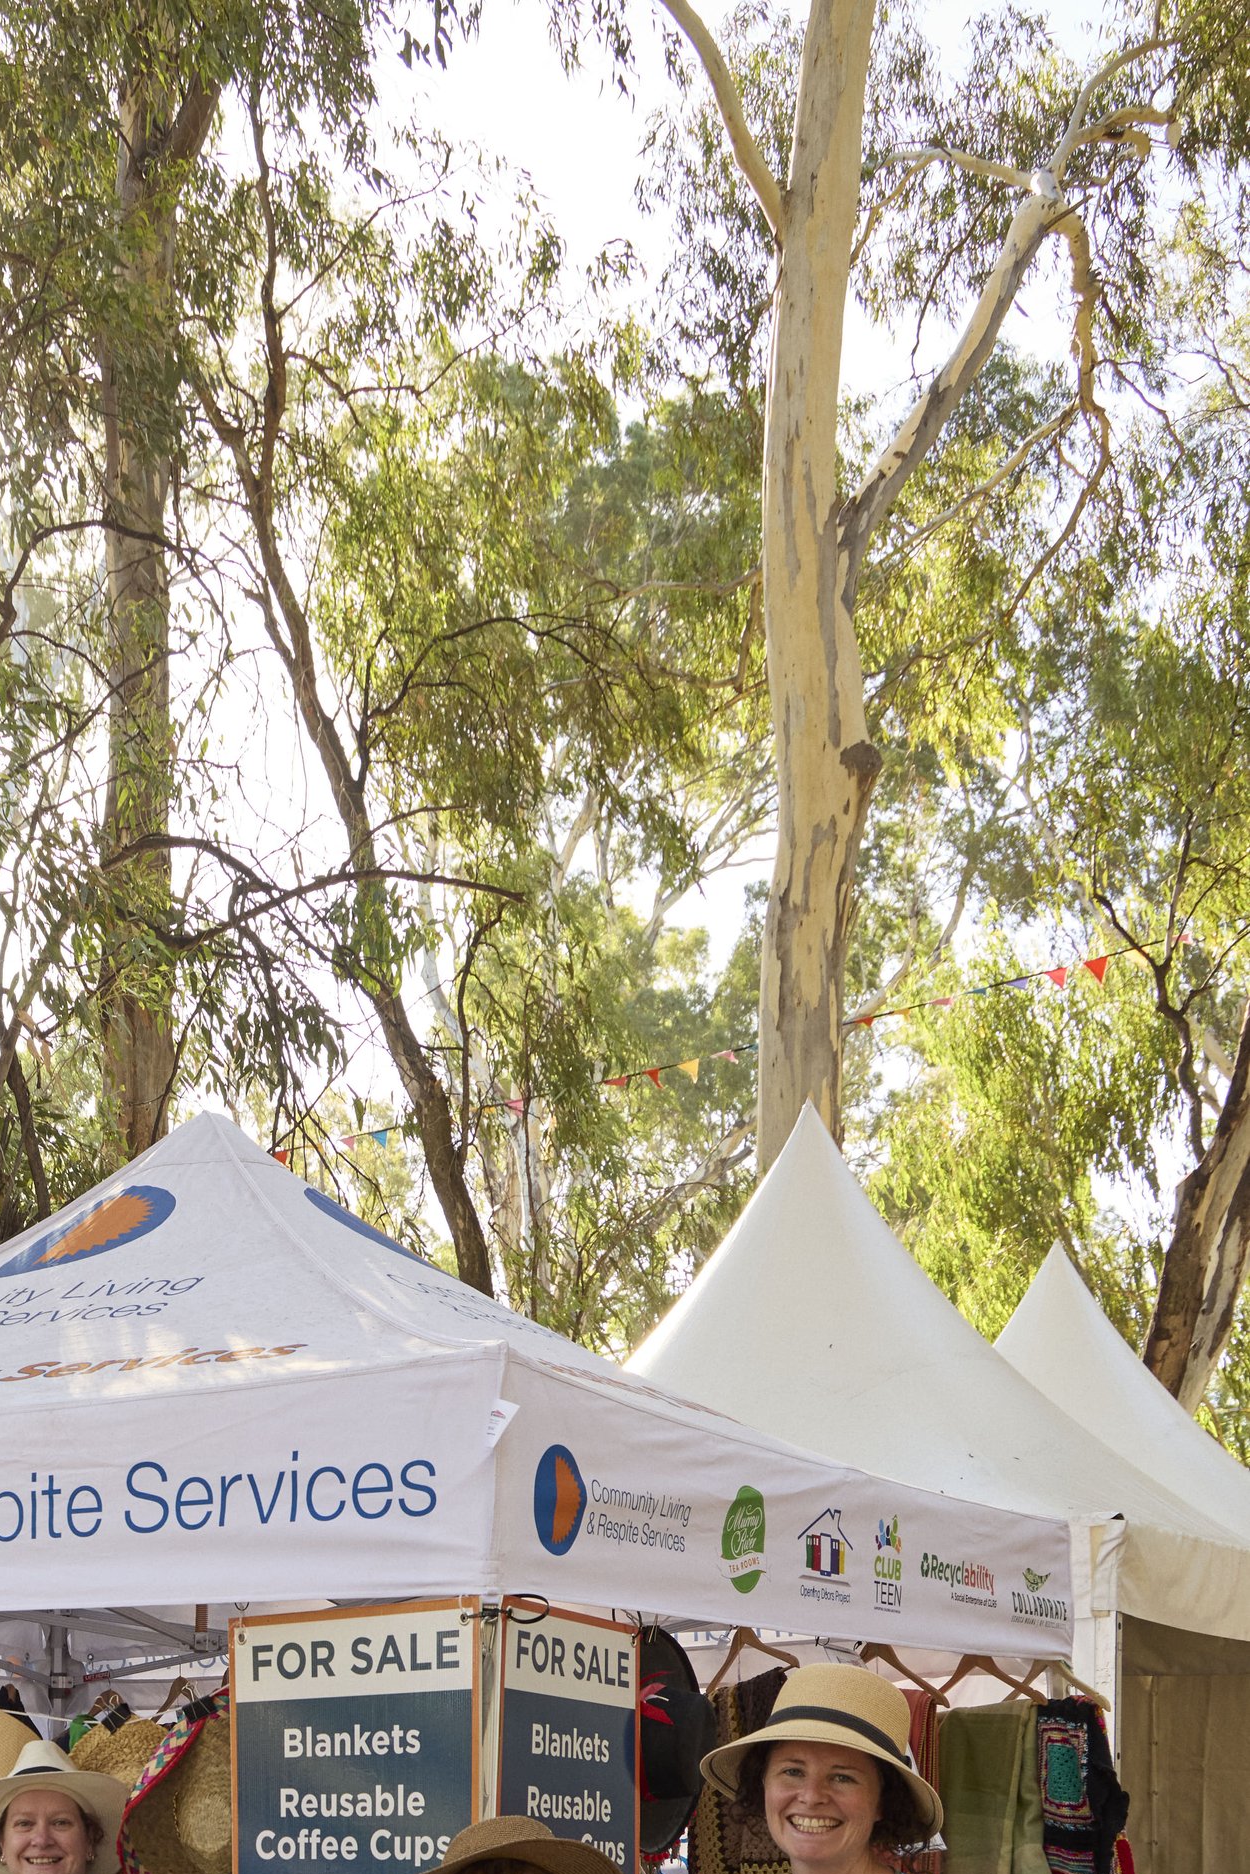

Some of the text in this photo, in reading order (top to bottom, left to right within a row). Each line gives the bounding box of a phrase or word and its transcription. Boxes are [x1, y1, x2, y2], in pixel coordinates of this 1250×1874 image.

[62, 1274, 206, 1297] Living
[124, 1450, 437, 1534] Services
[591, 1478, 692, 1528] Community Living
[586, 1511, 686, 1553] & Respite Services
[726, 1504, 762, 1537] Murray
[730, 1530, 757, 1558] River
[728, 1556, 761, 1574] TEA ROOMS
[874, 1554, 902, 1581] CLUB
[931, 1554, 995, 1596] Recyclability
[874, 1581, 902, 1607] TEEN
[1012, 1592, 1067, 1621] COLLABORATE
[252, 1641, 336, 1682] FOR
[351, 1630, 460, 1676] SALE
[516, 1630, 630, 1689] FOR SALE
[283, 1724, 421, 1758] Blankets
[531, 1723, 610, 1763] Blankets
[280, 1784, 426, 1818] Reusable
[527, 1785, 611, 1823] Reusable
[255, 1829, 451, 1867] Coffee Cups
